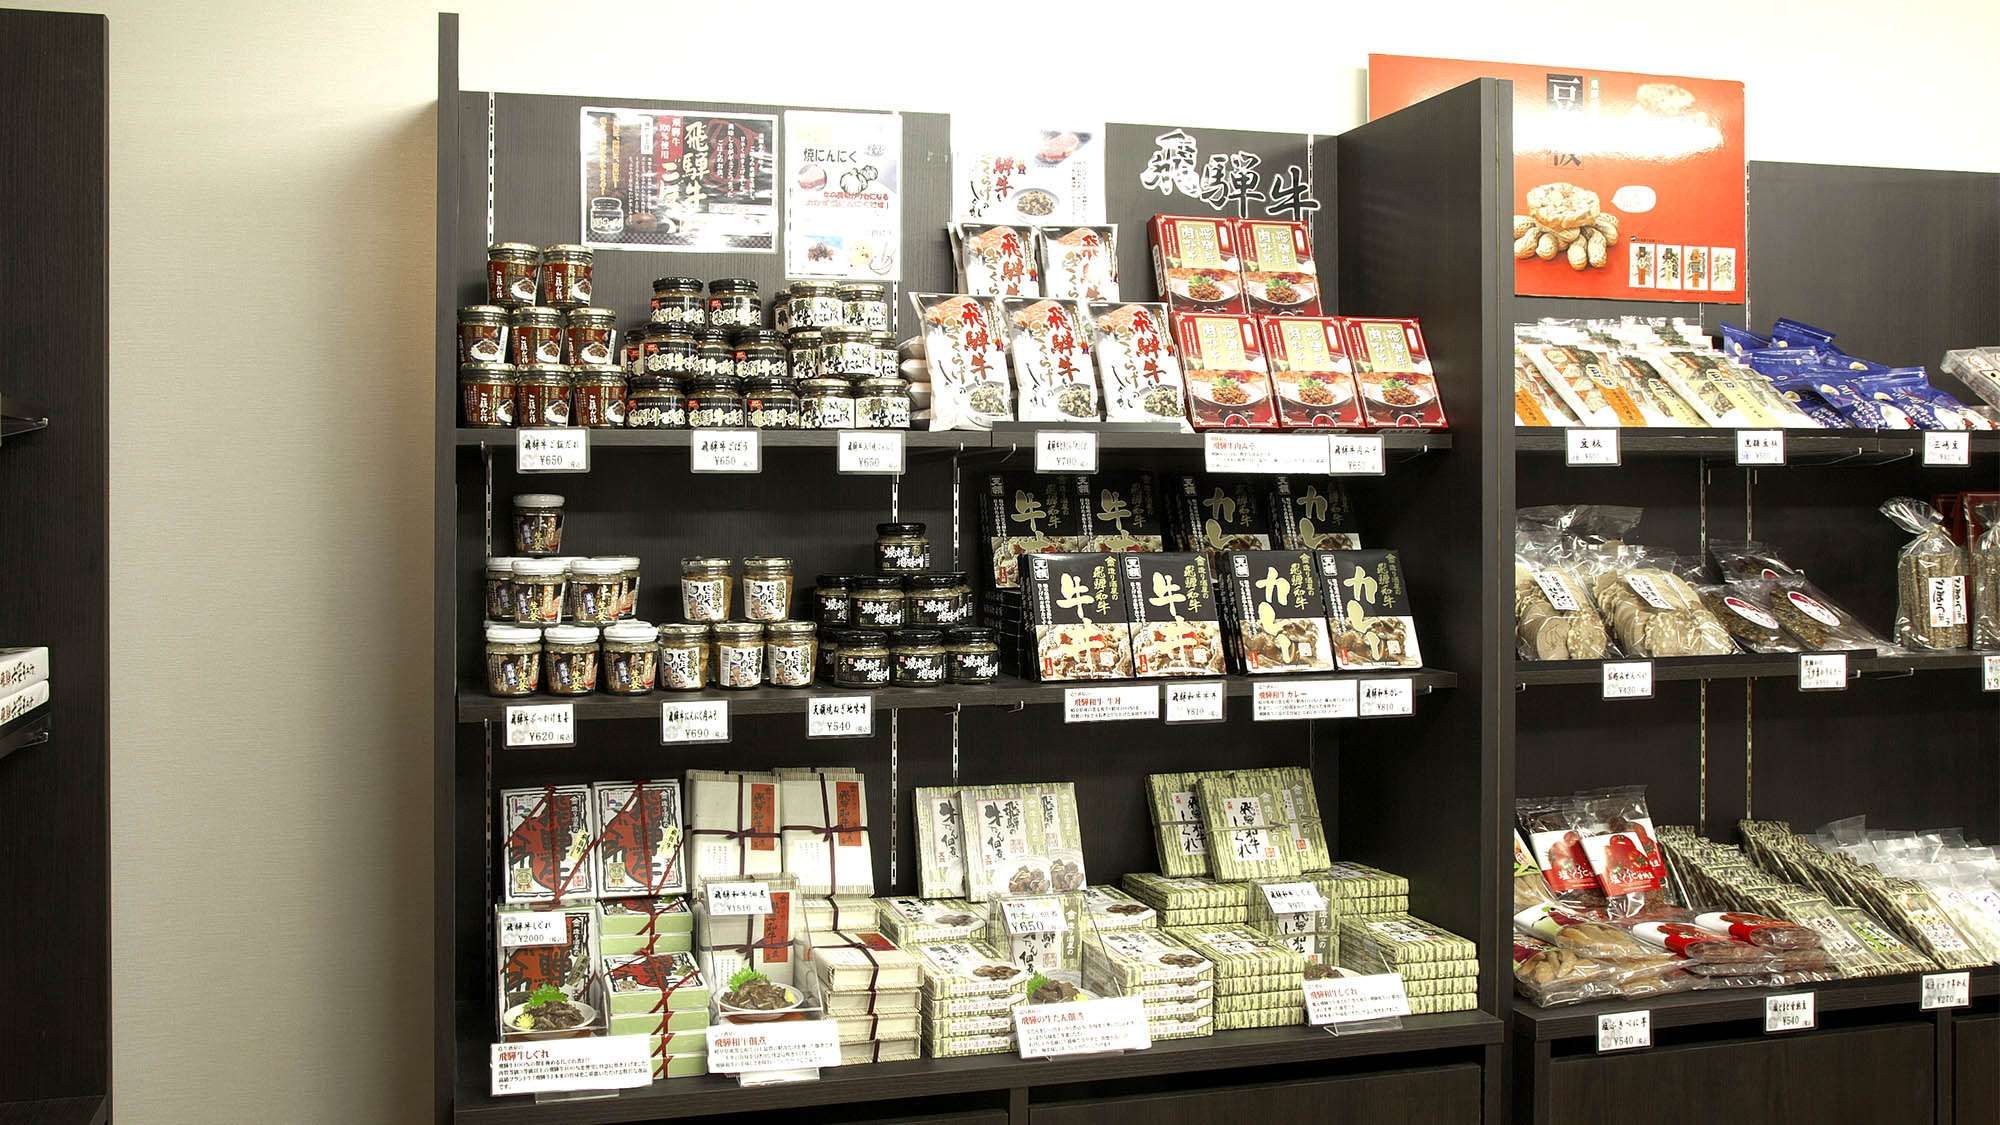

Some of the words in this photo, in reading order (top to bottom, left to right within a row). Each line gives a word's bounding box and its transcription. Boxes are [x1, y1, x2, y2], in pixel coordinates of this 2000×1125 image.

[803, 147, 857, 163] 焼にんにく
[1140, 128, 1321, 219] 飛騨牛
[540, 455, 563, 465] ¥650
[714, 456, 737, 466] ¥650
[1203, 487, 1236, 550] カレ
[1297, 485, 1328, 550] カレ
[1256, 566, 1294, 664] カレー
[1343, 566, 1381, 661] カレー
[827, 721, 851, 732] ¥540
[529, 732, 554, 742] ¥620
[685, 729, 709, 738] ¥690
[1011, 921, 1044, 933] ¥650
[518, 934, 545, 943] ¥2000
[1783, 1016, 1800, 1026] ¥540
[1614, 1036, 1633, 1047] ¥540
[499, 1050, 550, 1062] 飛騨牛しぐれ
